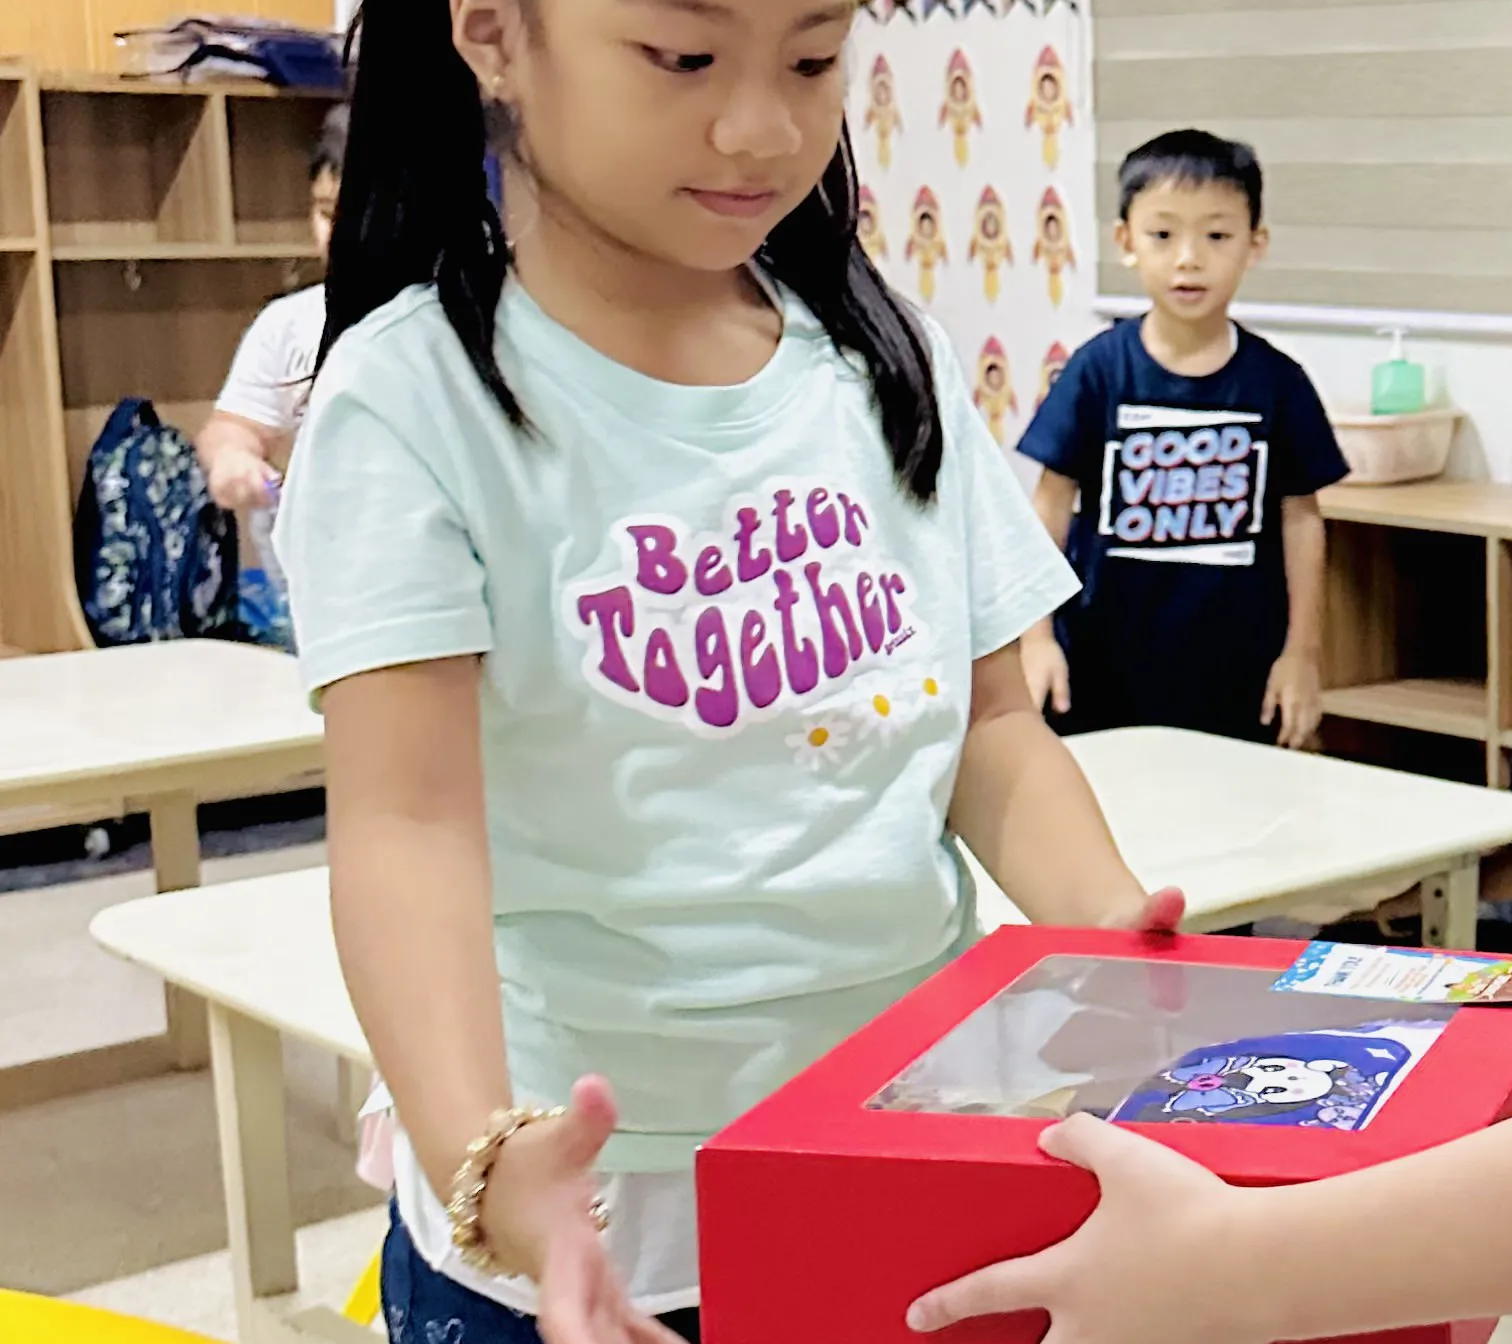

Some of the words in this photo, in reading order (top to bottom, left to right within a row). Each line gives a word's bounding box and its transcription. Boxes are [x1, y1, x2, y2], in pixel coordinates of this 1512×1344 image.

[1122, 426, 1251, 469] GOOD
[1119, 463, 1250, 505] VIBES
[627, 487, 868, 595] Better
[1115, 500, 1248, 542] ONLY
[577, 561, 905, 727] Together
